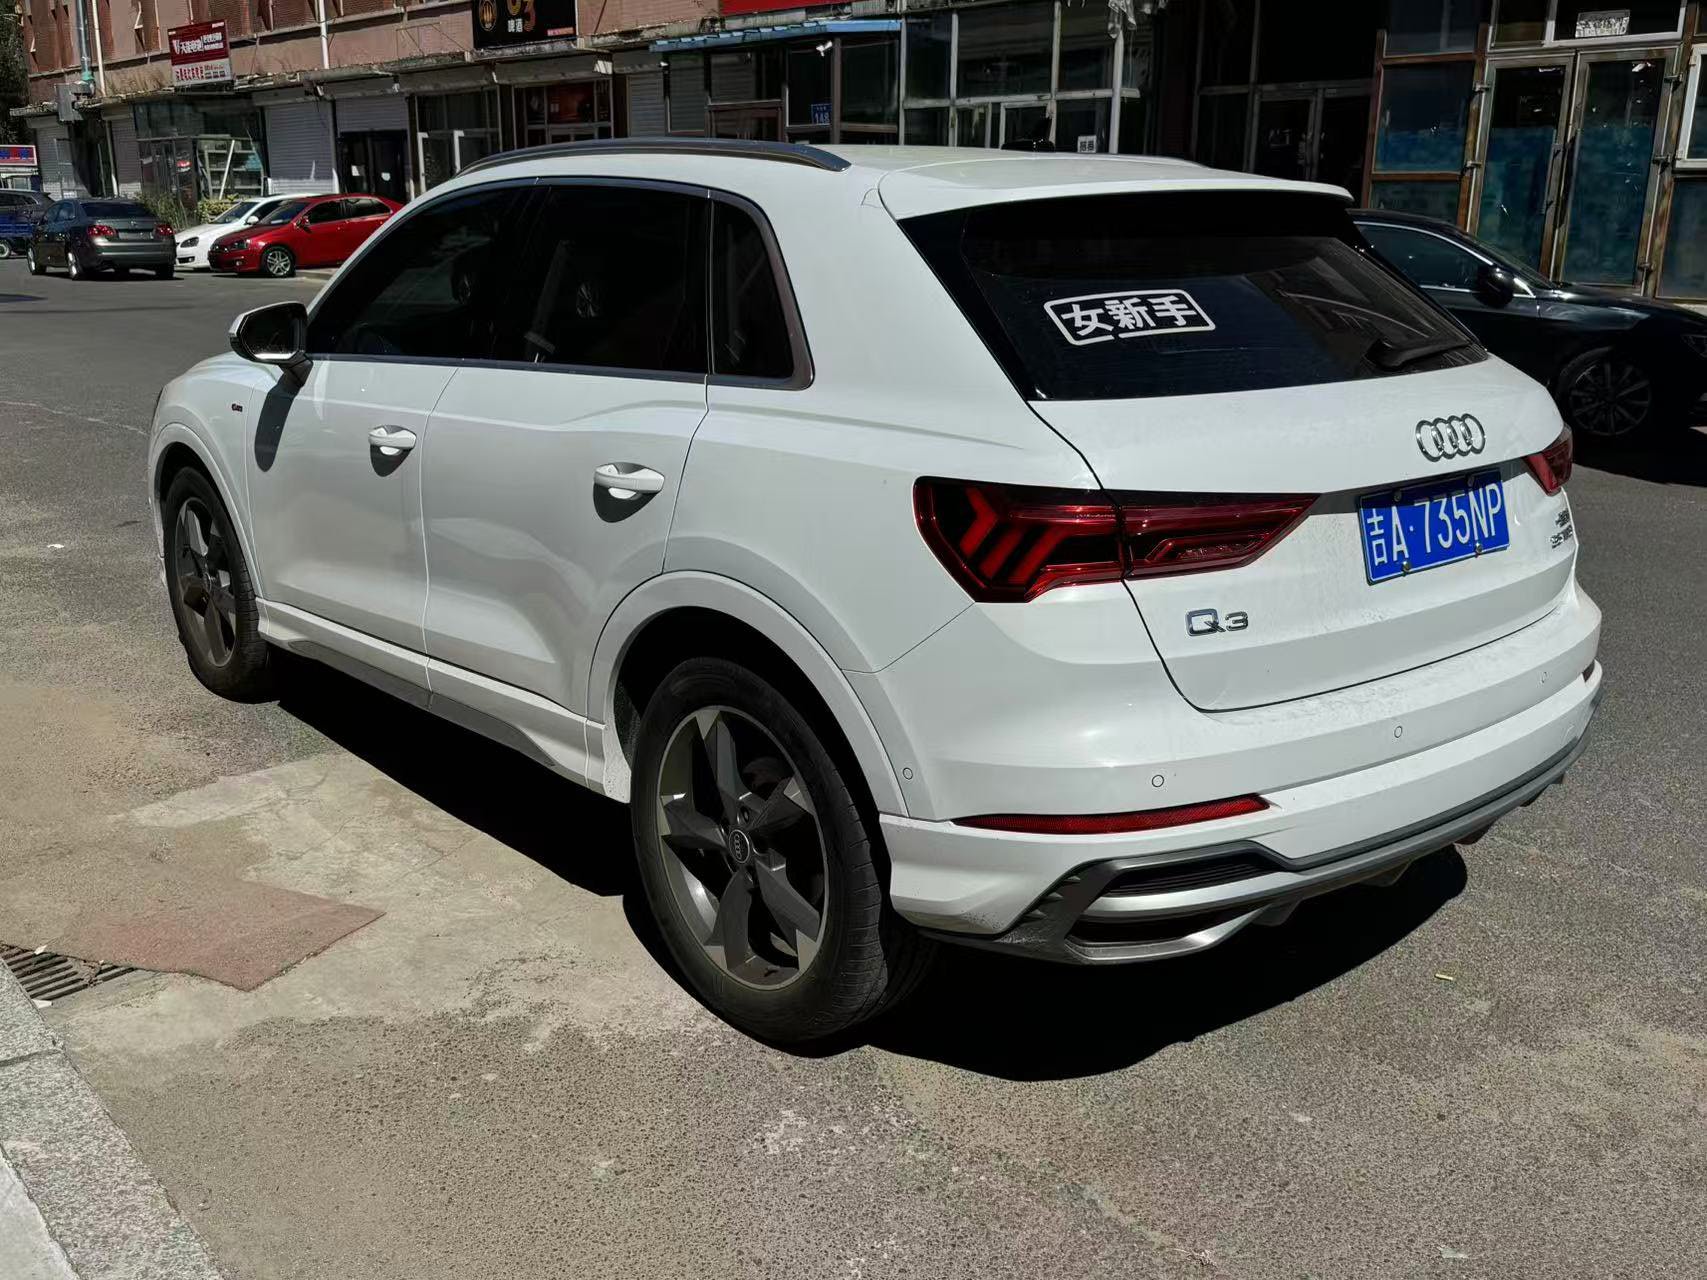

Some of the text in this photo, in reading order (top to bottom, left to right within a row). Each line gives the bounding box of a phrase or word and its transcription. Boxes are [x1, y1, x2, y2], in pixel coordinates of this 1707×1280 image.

[1061, 295, 1197, 336] 女新手
[1185, 608, 1249, 637] Q3
